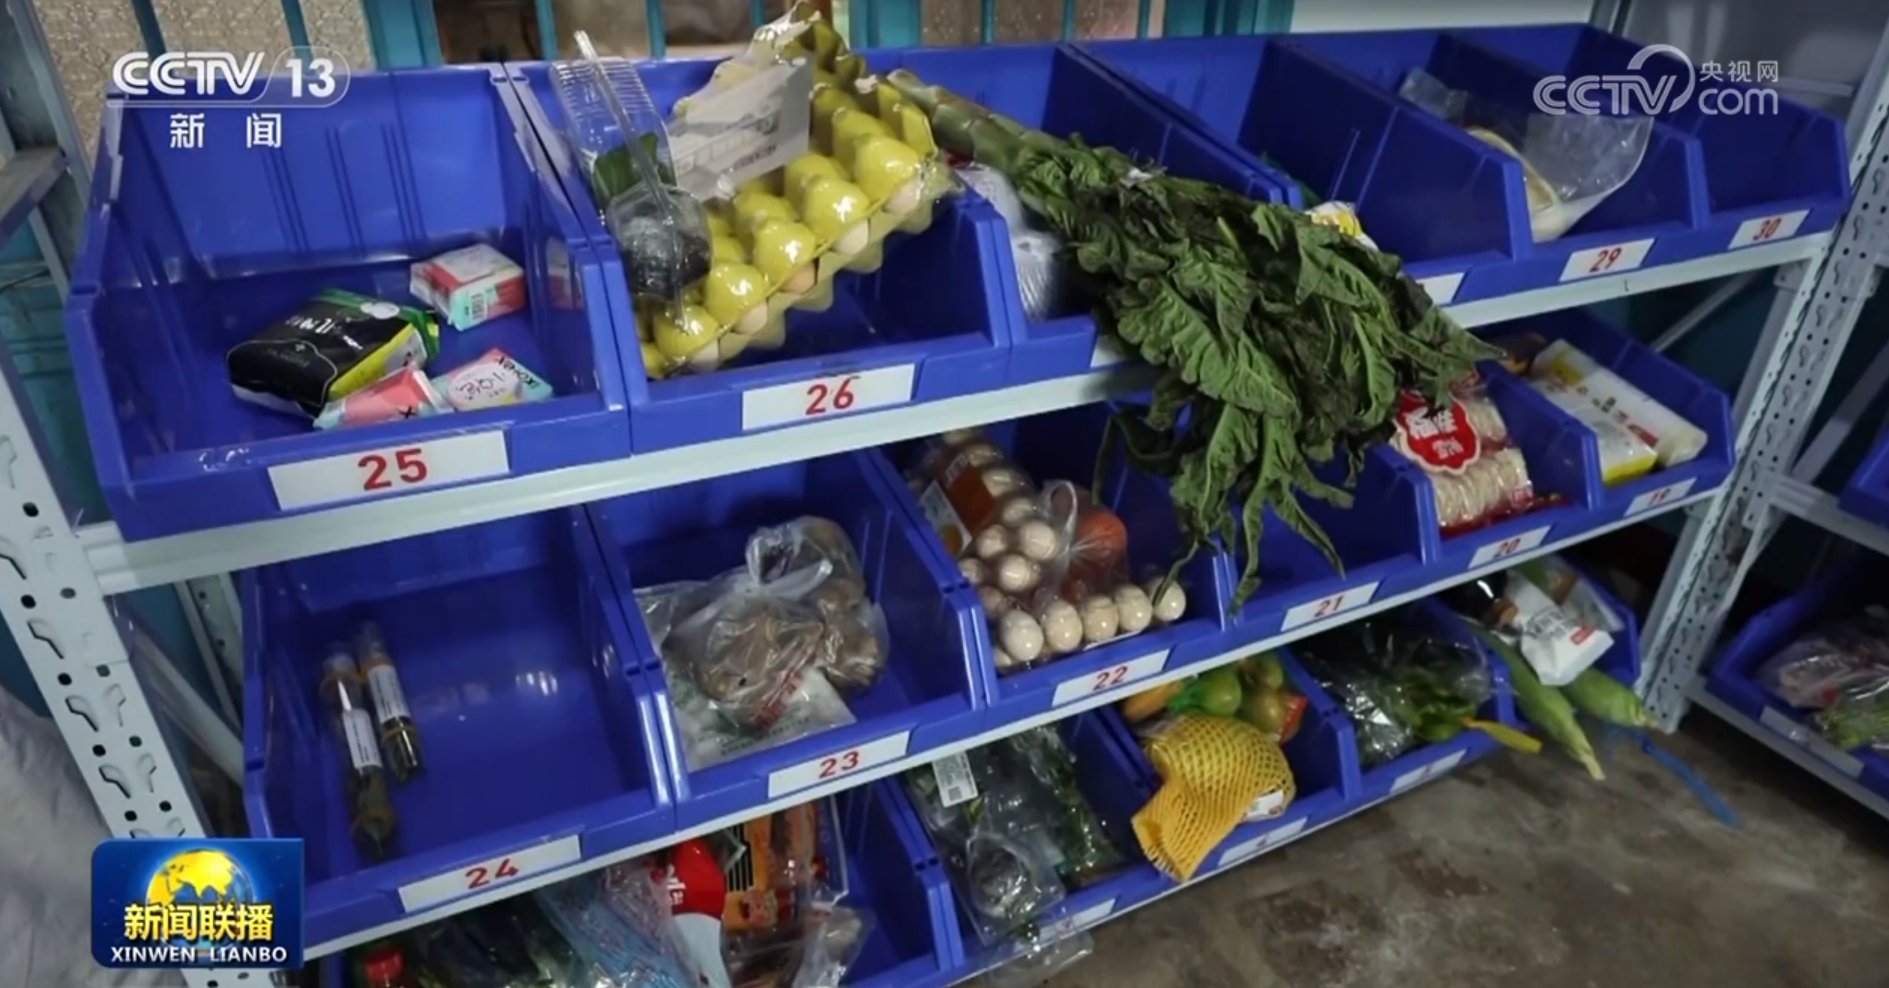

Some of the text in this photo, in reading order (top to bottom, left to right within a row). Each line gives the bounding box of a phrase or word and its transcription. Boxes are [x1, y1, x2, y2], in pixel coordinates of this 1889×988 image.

[1752, 217, 1783, 242] 30
[1588, 247, 1624, 274] 29
[805, 376, 858, 415] 26
[358, 447, 429, 492] 25
[1494, 536, 1522, 560] 20
[1313, 594, 1344, 619] 21
[1094, 664, 1129, 692] 22
[819, 749, 862, 782] 23
[466, 858, 519, 888] 24
